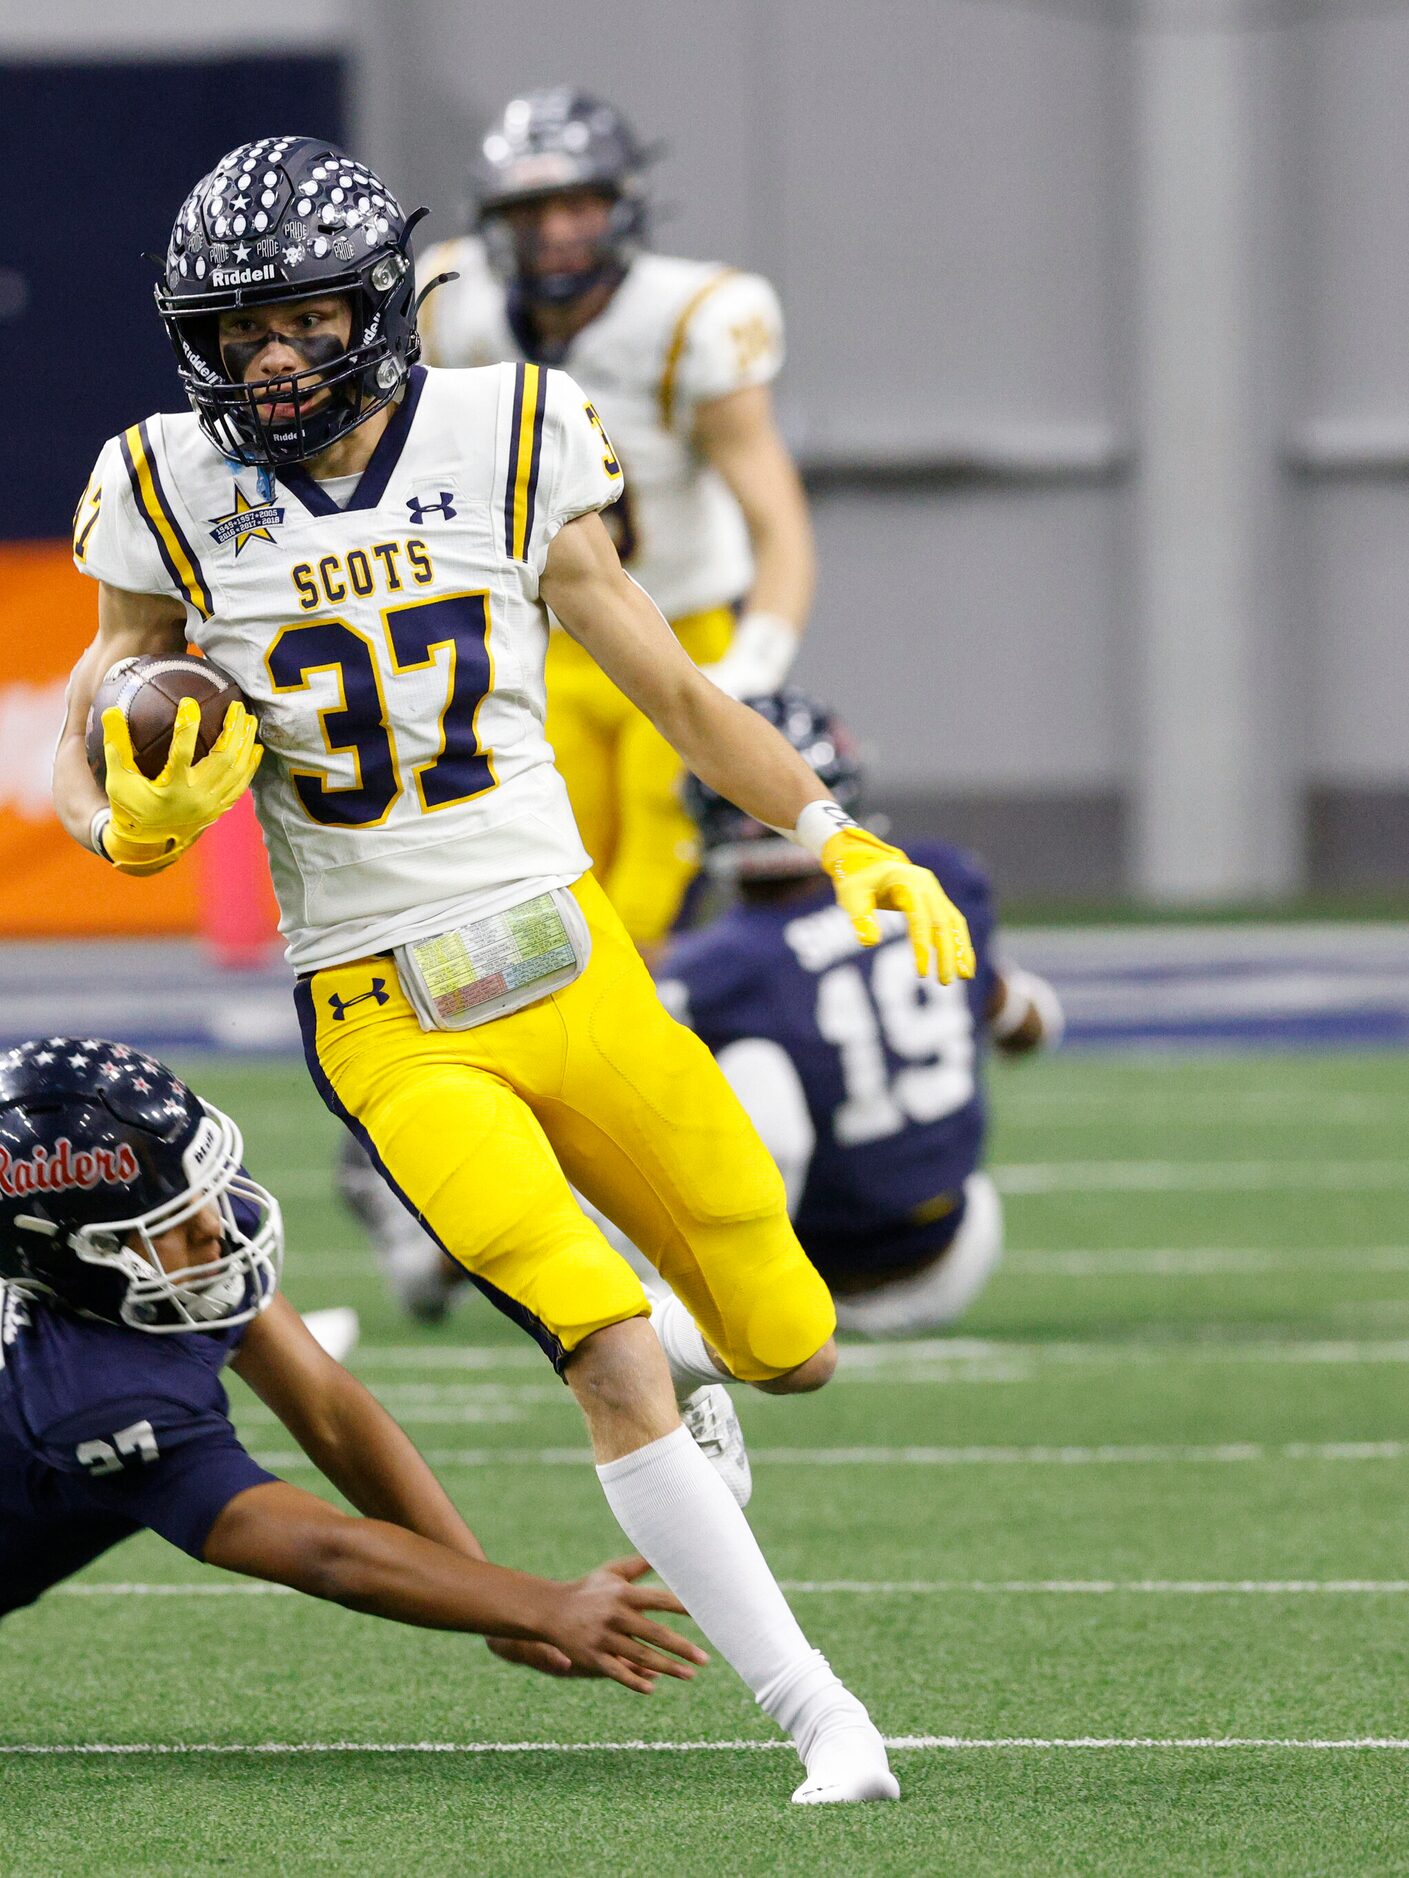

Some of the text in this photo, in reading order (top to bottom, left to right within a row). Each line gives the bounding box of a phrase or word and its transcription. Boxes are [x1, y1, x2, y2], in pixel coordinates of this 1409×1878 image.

[284, 222, 308, 239] PRIDE
[256, 239, 279, 258] PRIDE
[212, 264, 275, 287] Riddell
[181, 341, 219, 385] Riddell
[216, 509, 278, 535] 1945 1957 2005
[218, 516, 280, 542] 2016 2017 2018
[291, 539, 434, 612] SCOTS
[264, 588, 500, 829] 37
[815, 936, 978, 1147] 19
